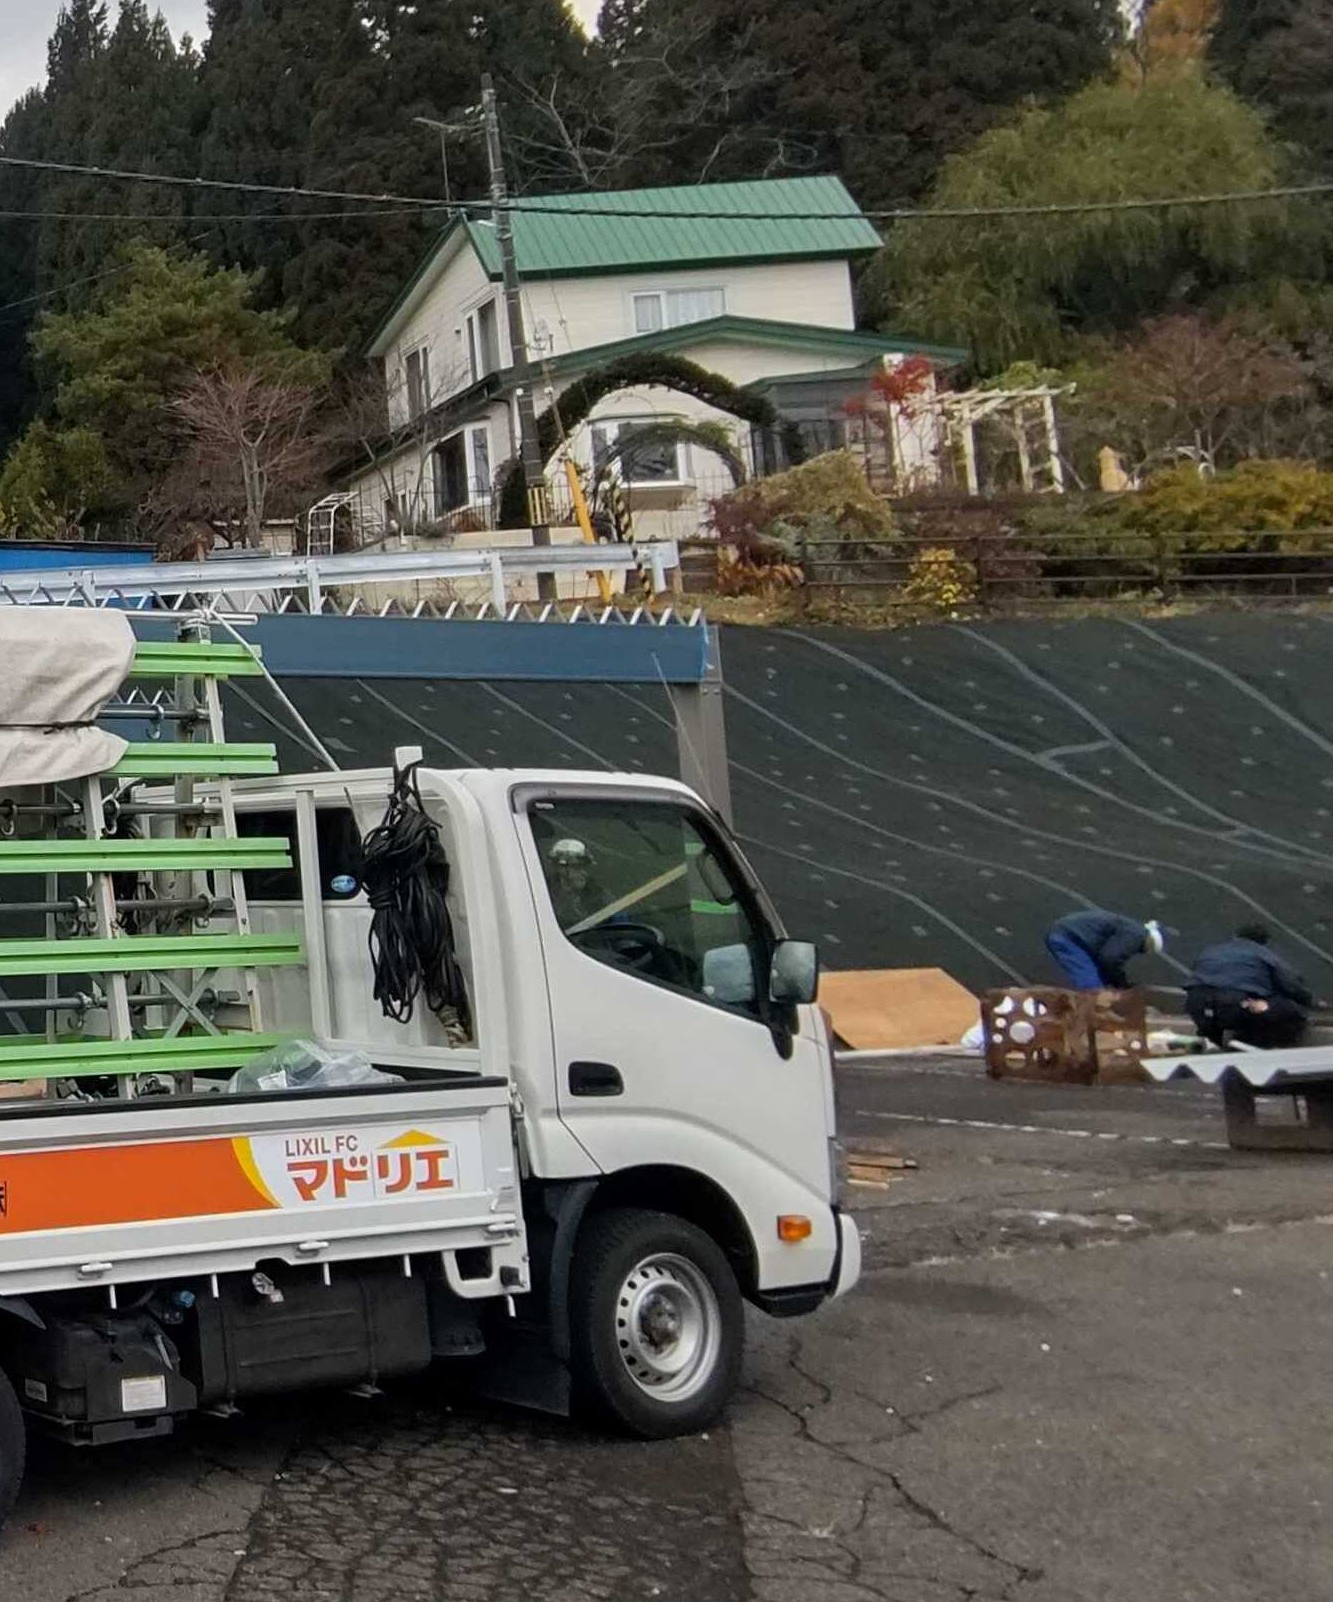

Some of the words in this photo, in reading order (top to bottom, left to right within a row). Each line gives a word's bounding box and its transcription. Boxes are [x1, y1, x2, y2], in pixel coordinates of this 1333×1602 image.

[285, 1137, 330, 1157] LIXIL
[335, 1135, 358, 1151] FC
[287, 1150, 454, 1200] マドリエ
